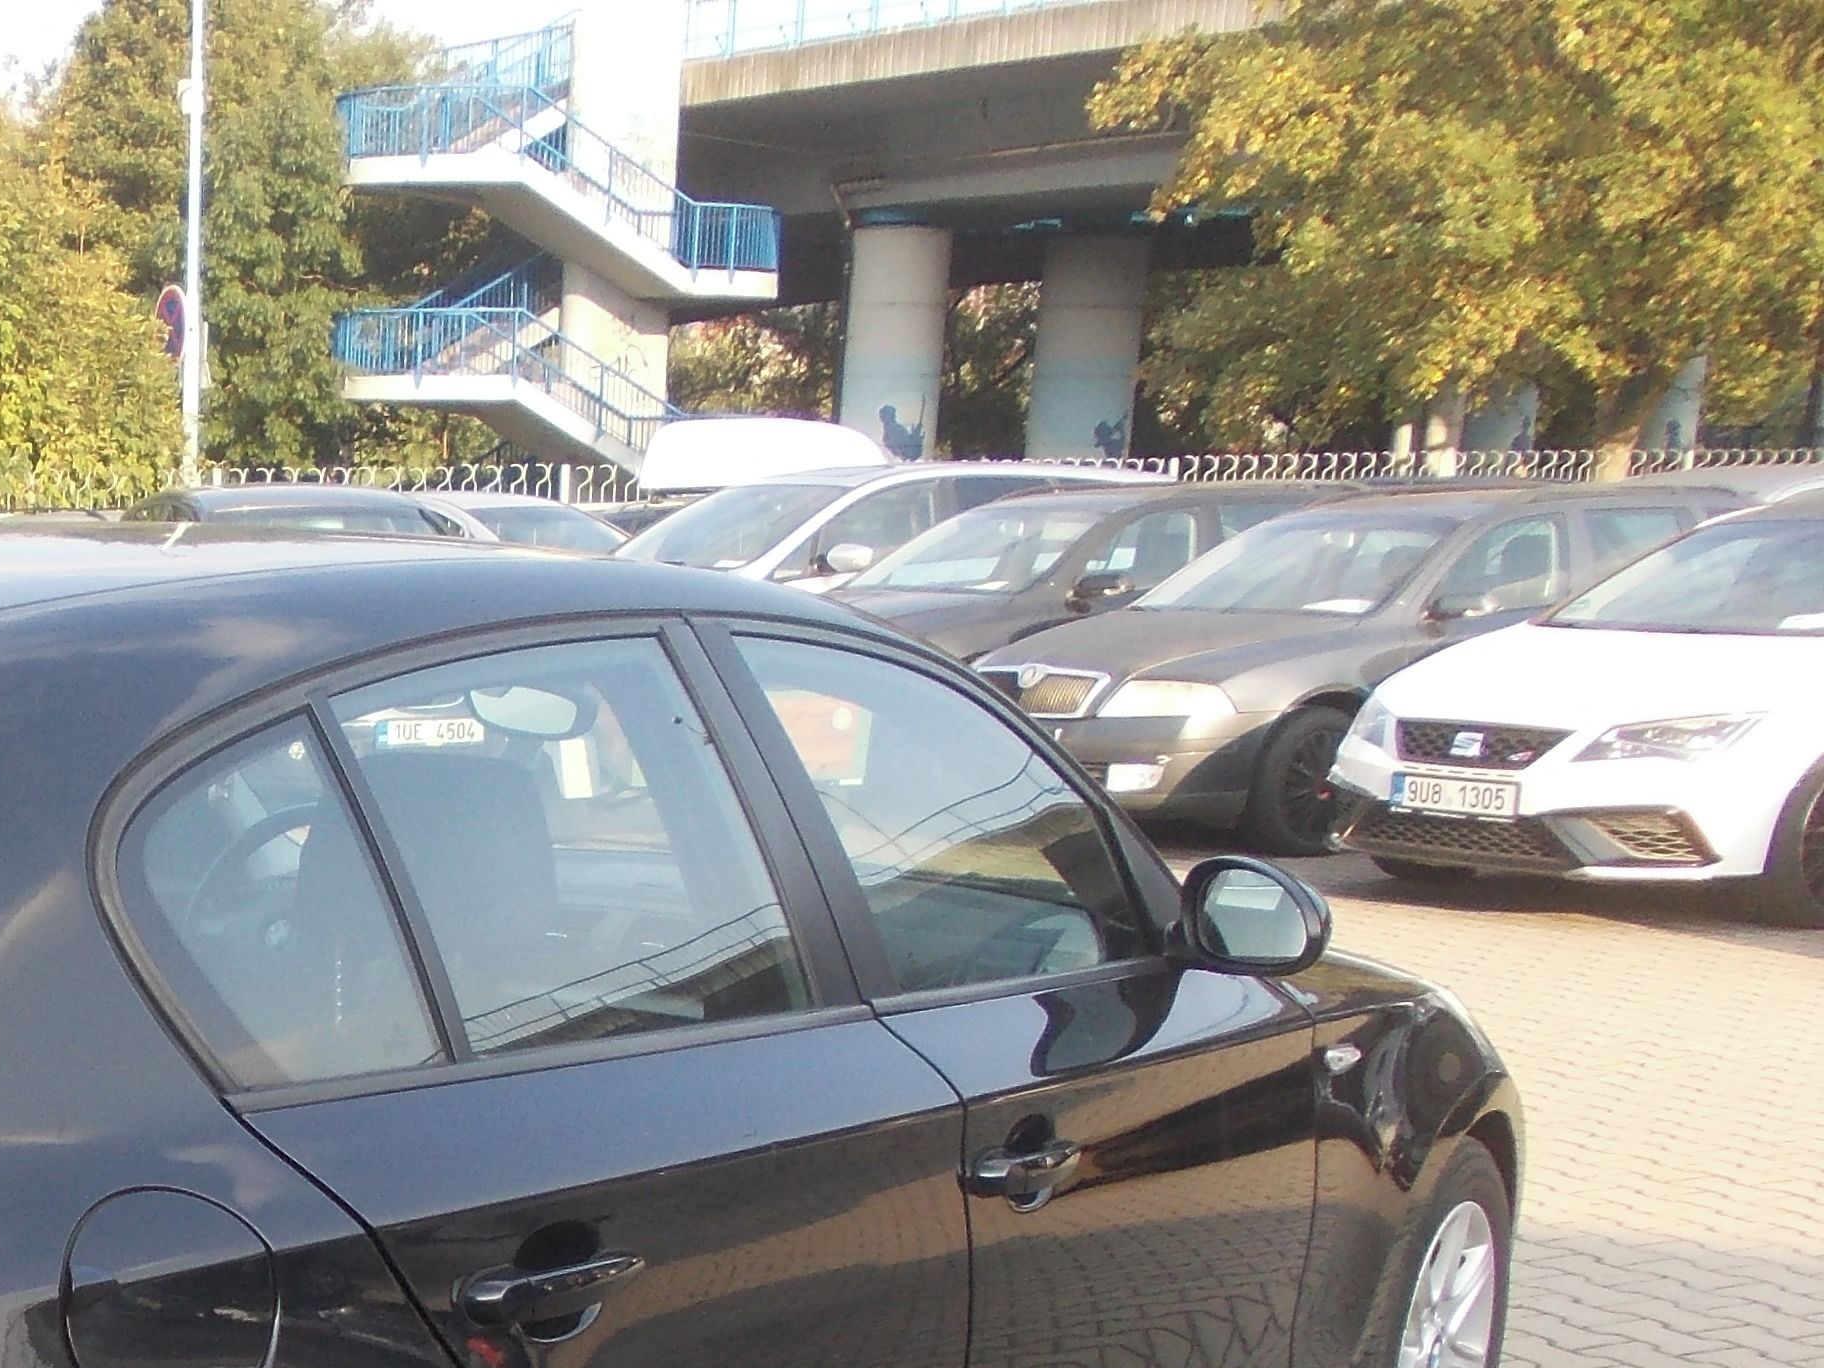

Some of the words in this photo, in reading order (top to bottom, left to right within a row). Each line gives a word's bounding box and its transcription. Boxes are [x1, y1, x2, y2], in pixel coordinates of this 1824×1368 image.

[395, 723, 423, 741] 1UE
[436, 722, 475, 741] 4504
[1407, 780, 1443, 804] 9U8
[1458, 785, 1506, 811] 1305
